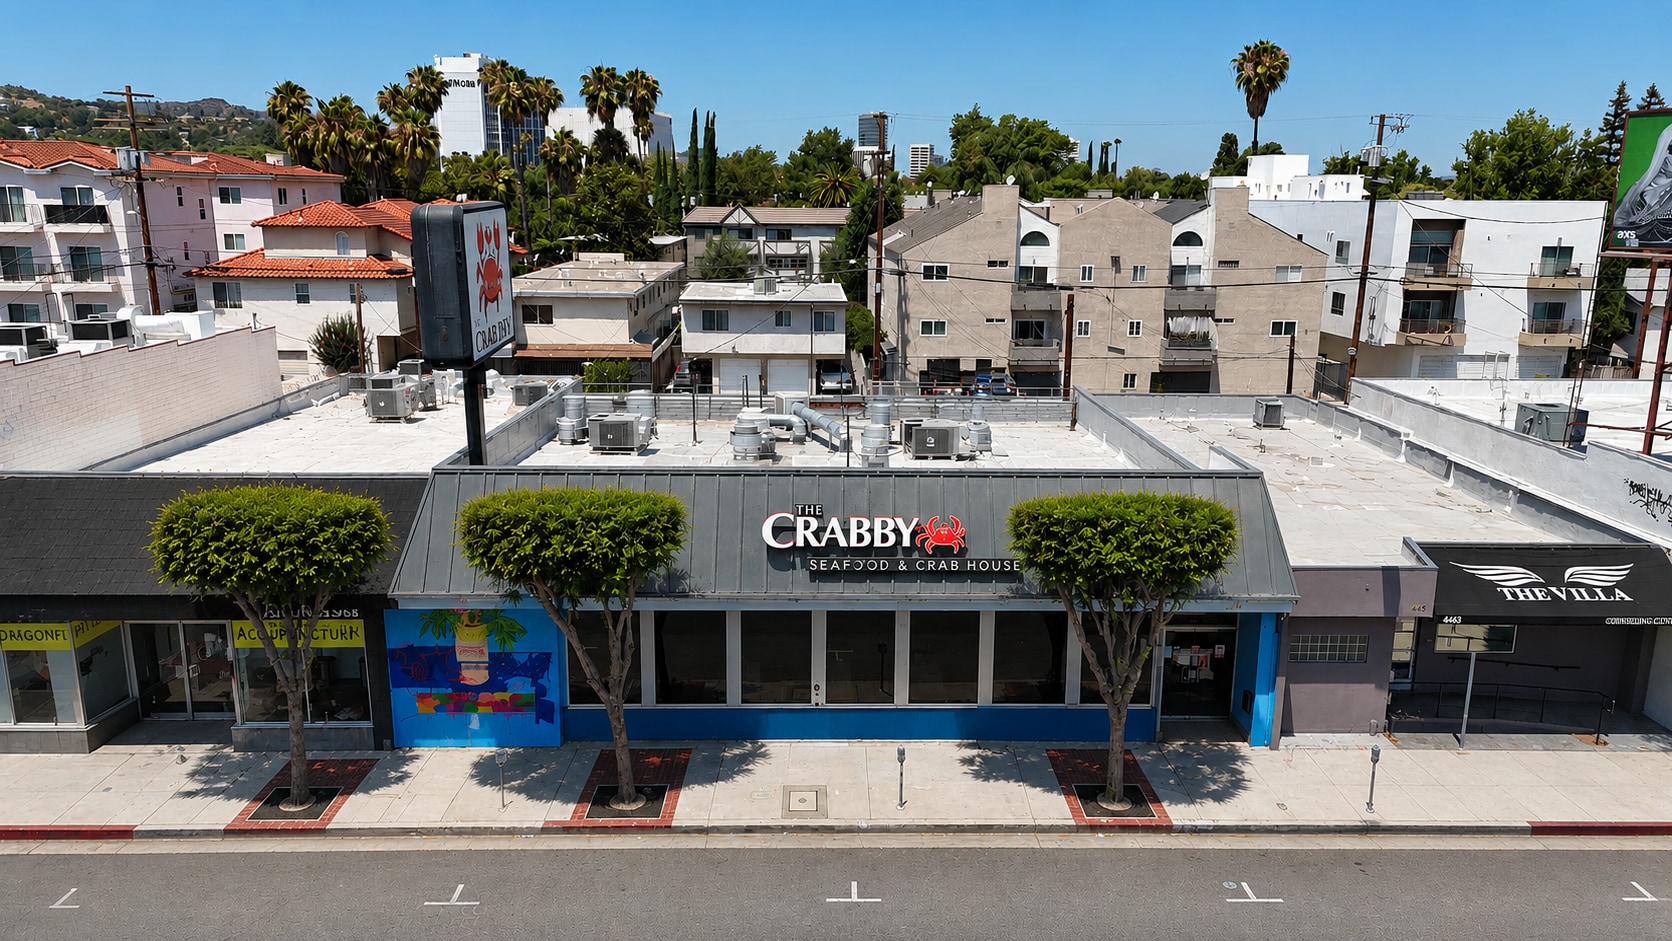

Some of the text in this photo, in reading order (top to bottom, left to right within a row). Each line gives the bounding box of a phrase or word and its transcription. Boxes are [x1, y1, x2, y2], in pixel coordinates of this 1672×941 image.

[796, 504, 823, 516] THE
[761, 511, 919, 549] CRABBY
[810, 559, 1020, 571] SEAFOOD & CRAB HOUSE
[1496, 586, 1634, 601] THE VILLA
